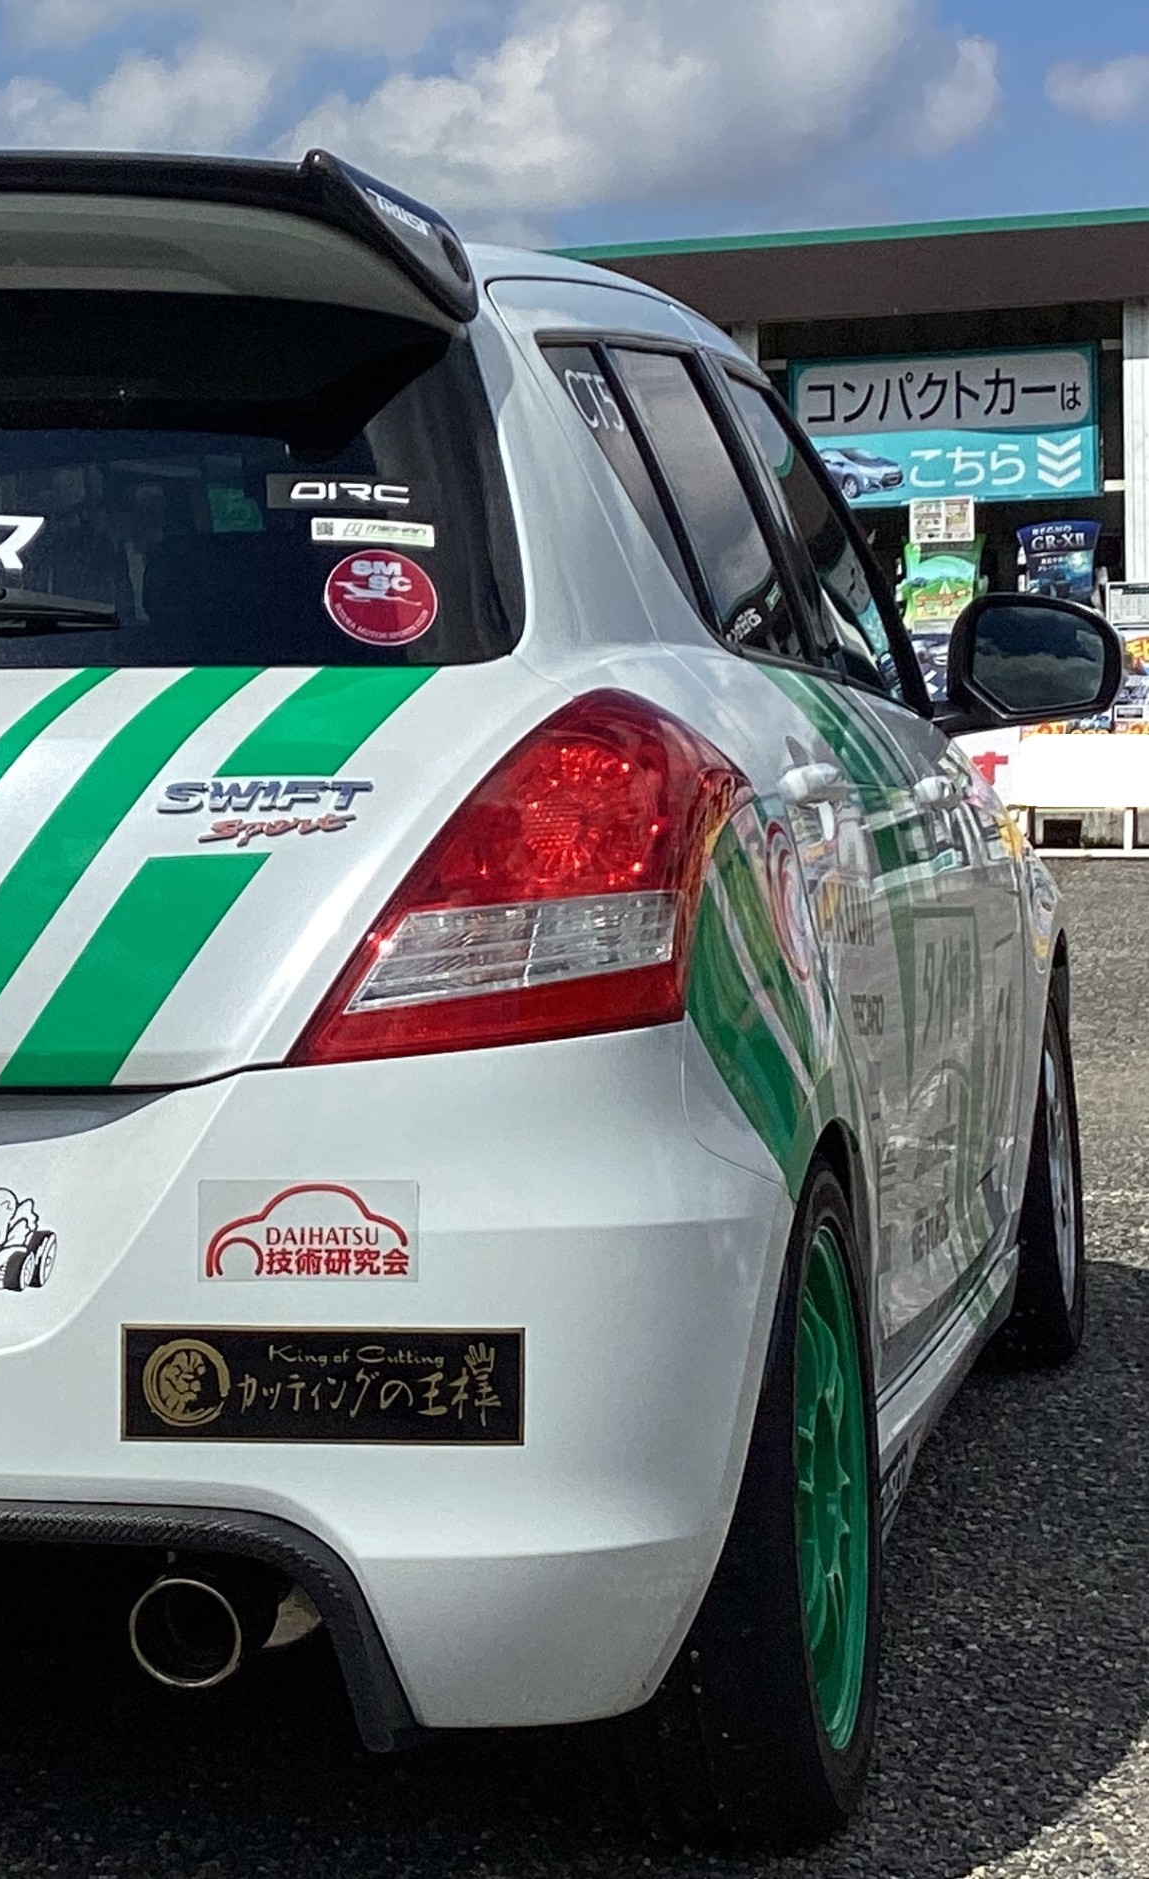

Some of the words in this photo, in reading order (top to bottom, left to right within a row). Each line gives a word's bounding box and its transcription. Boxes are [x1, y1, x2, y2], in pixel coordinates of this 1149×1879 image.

[807, 367, 1082, 424] コンパクトカーは
[908, 443, 1026, 488] こちら
[157, 781, 374, 814] SWIFT
[198, 813, 357, 847] Sport
[265, 1226, 379, 1246] DAIHATSU
[265, 1248, 410, 1276] 技術研究会
[268, 1344, 329, 1367] King
[334, 1348, 351, 1364] of
[356, 1344, 445, 1368] Cutting
[238, 1364, 502, 1427] カッティングの王様
